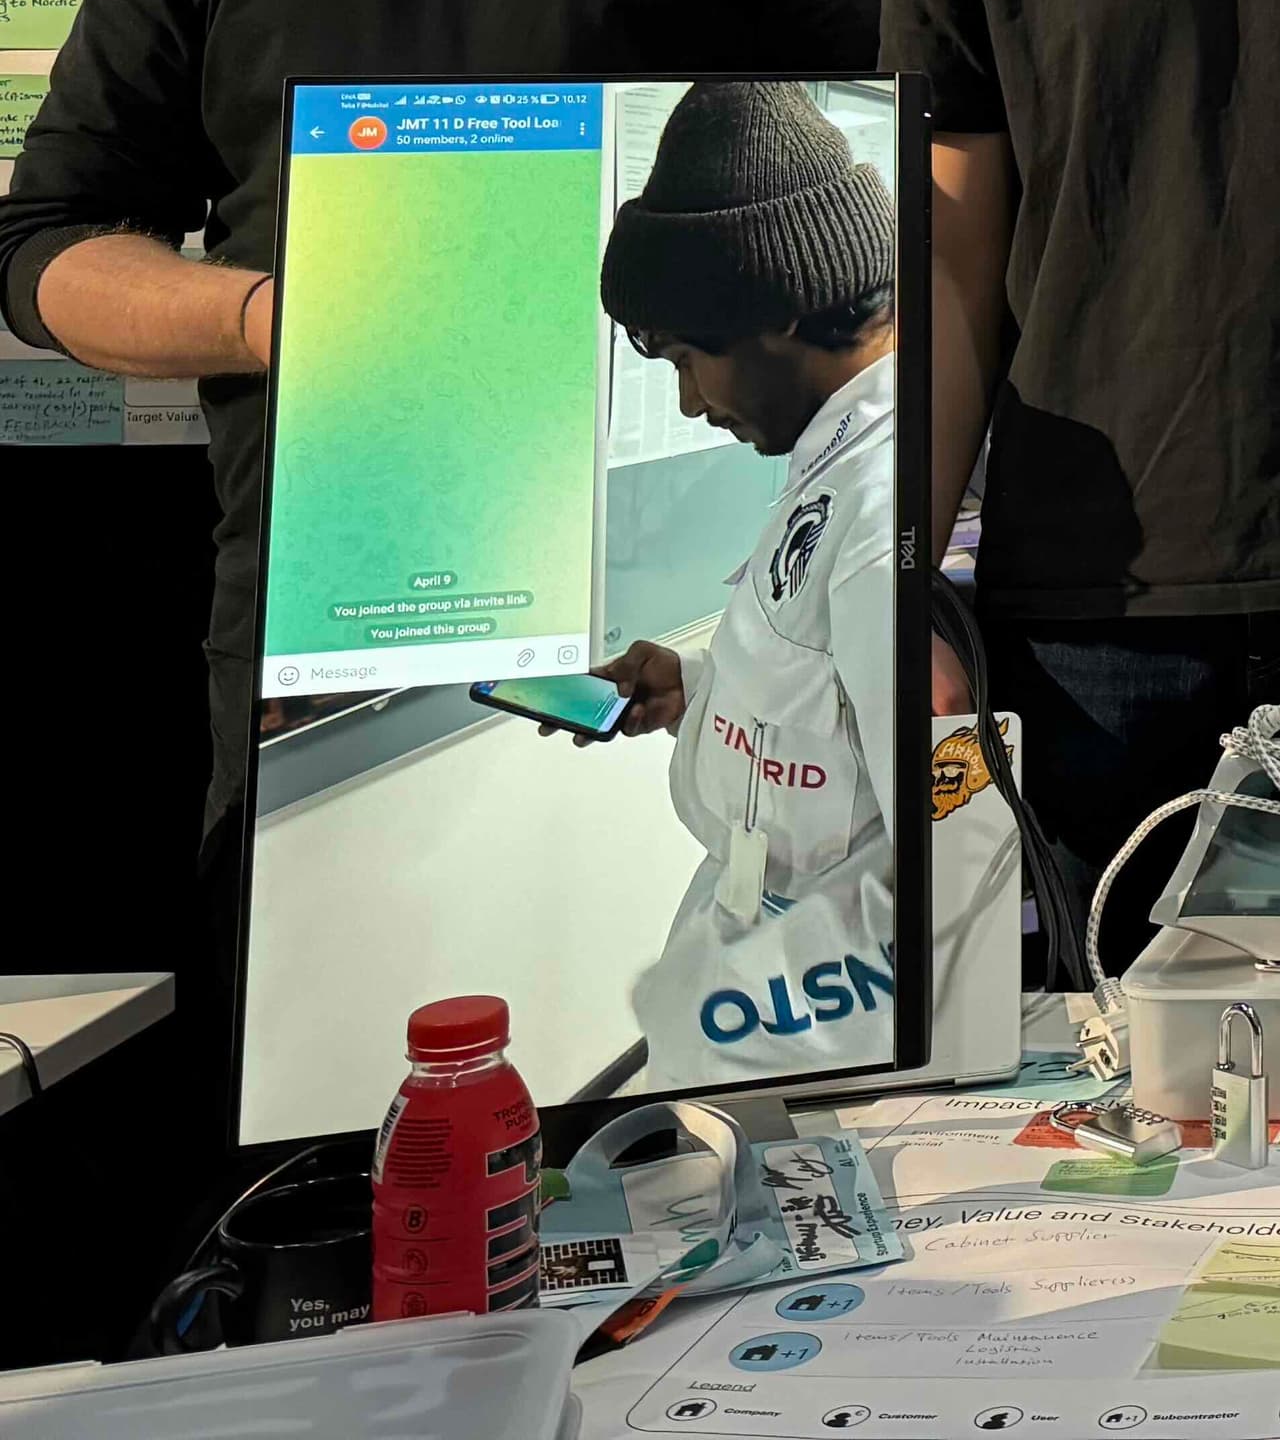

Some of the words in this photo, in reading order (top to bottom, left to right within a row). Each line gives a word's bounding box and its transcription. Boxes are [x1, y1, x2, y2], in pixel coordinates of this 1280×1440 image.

[562, 94, 587, 104] 10.12
[396, 117, 428, 131] JMT
[453, 117, 464, 131] D
[467, 116, 498, 130] Free
[500, 116, 530, 130] Tool
[357, 127, 378, 137] JM
[396, 134, 411, 145] 50
[413, 133, 467, 146] members,
[480, 133, 514, 144] online
[127, 412, 163, 424] Target
[166, 411, 200, 423] Value
[901, 526, 915, 569] DELL
[414, 575, 440, 589] April
[334, 605, 356, 618] You
[357, 603, 394, 619] joined
[397, 602, 416, 614] the
[418, 600, 451, 614] group
[453, 598, 470, 609] via
[473, 595, 504, 608] invite
[506, 594, 527, 605] link
[370, 627, 392, 640] You
[394, 625, 431, 640] joined
[433, 624, 455, 635] this
[457, 622, 490, 636] group
[310, 665, 377, 682] Message
[945, 1098, 1041, 1112] Impact
[961, 1208, 1042, 1225] Value
[1051, 1210, 1112, 1222] and
[925, 1232, 1016, 1252] Cabinet
[289, 1314, 324, 1332] you
[332, 1303, 371, 1324] may
[689, 1381, 756, 1394] Legend
[724, 1407, 782, 1419] Company
[878, 1411, 939, 1421] Customer
[1031, 1413, 1061, 1422] User
[1152, 1411, 1240, 1422] Subcontractor
